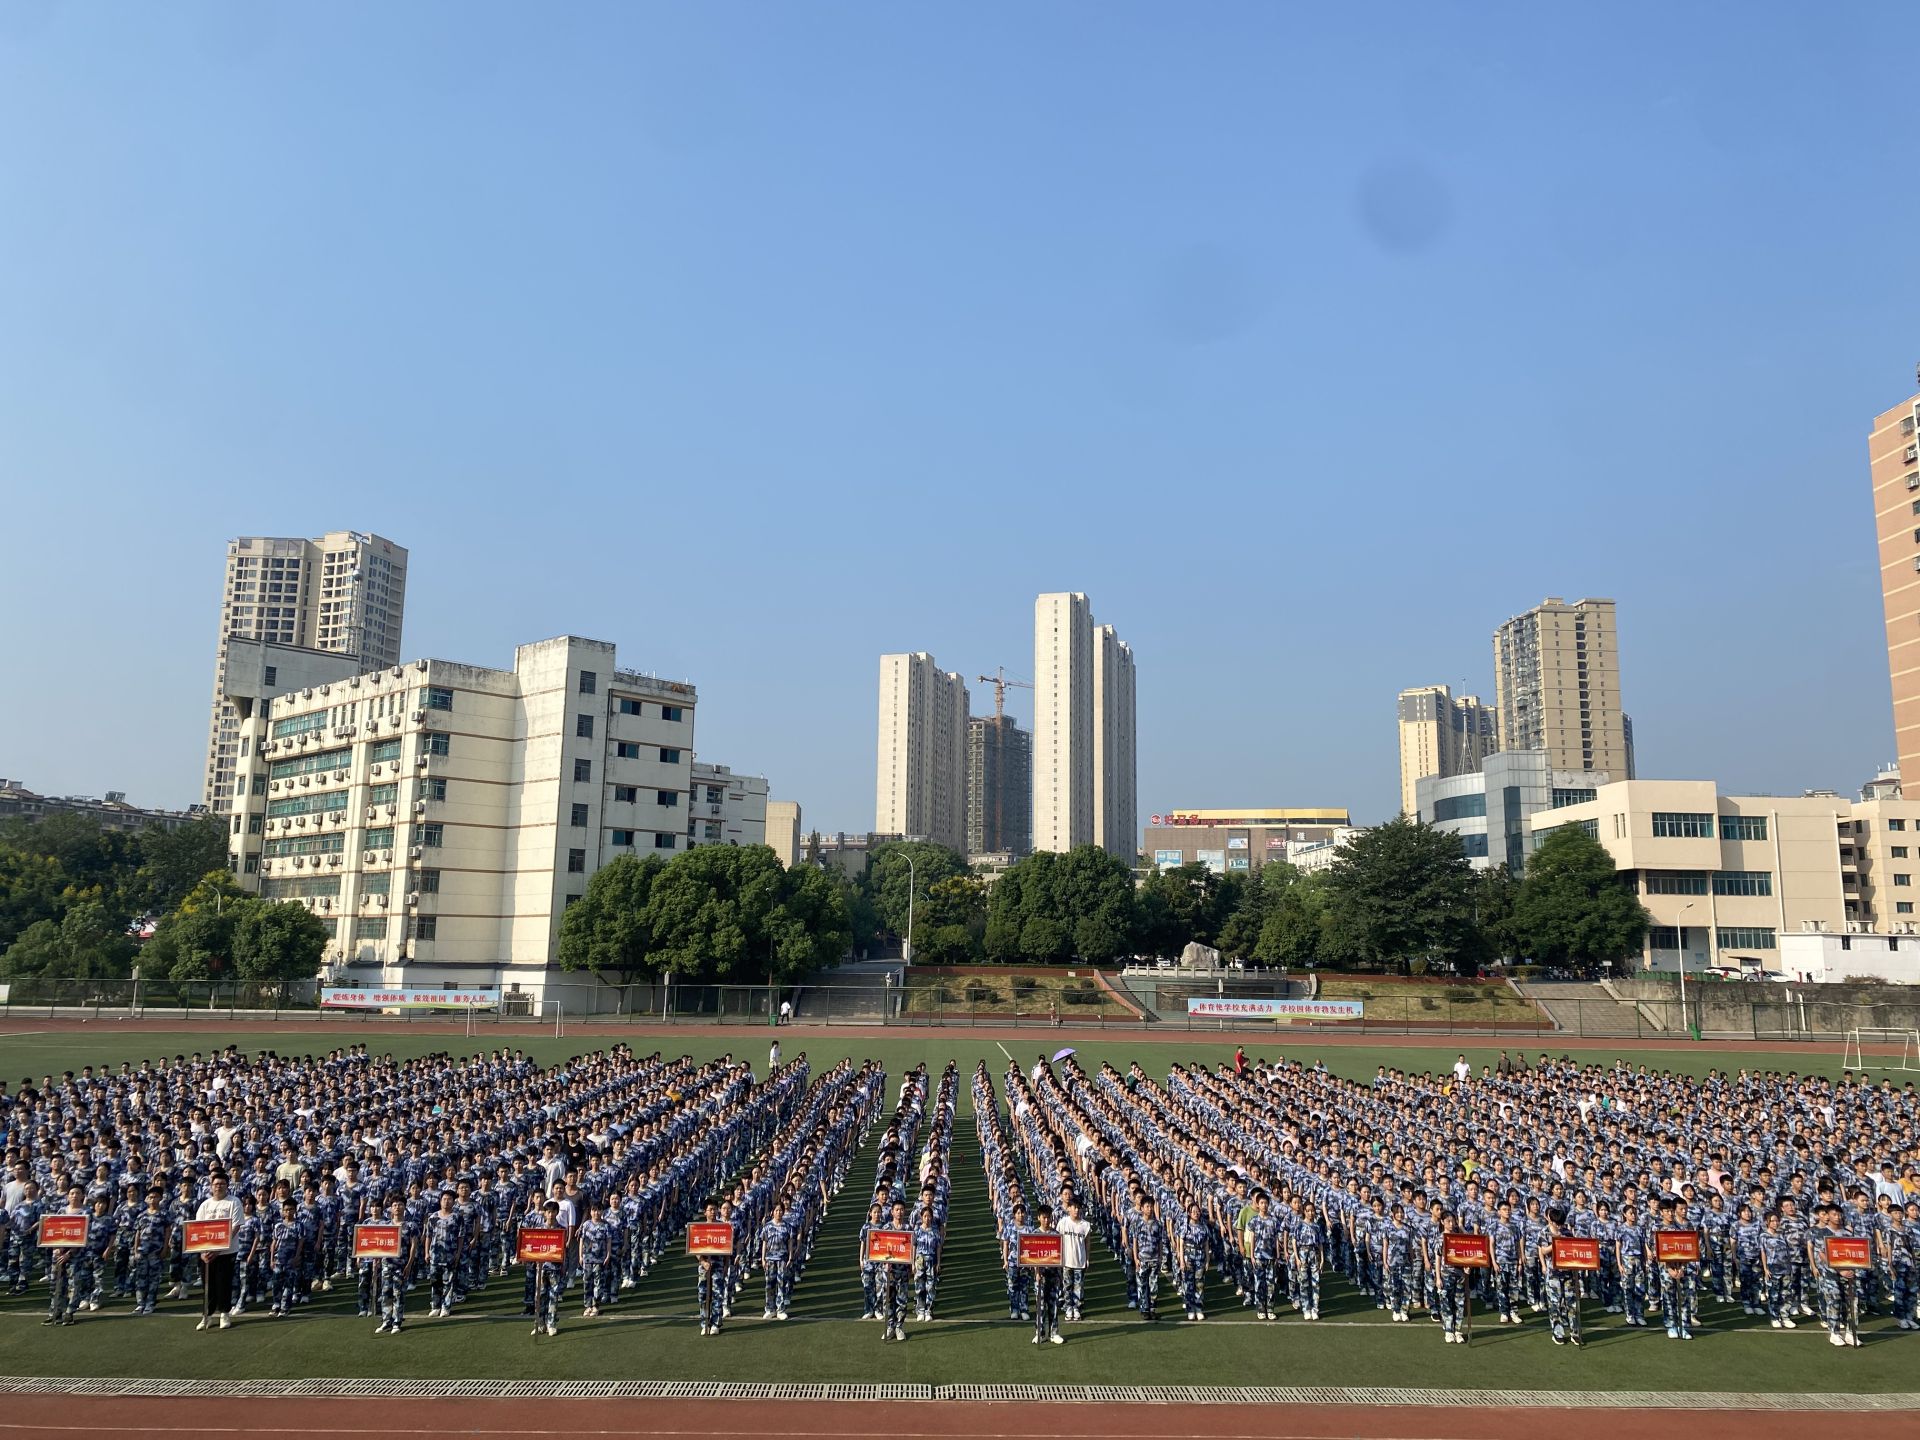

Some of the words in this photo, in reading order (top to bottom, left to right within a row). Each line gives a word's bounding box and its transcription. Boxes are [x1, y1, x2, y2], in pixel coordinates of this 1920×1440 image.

[373, 994, 406, 1002] 增强体质
[414, 994, 446, 1003] 报效祖国
[453, 994, 487, 1003] 服务人民
[1199, 1003, 1272, 1013] 体育使学校充满活力
[46, 1229, 81, 1237] 高一(6)班
[190, 1232, 227, 1241] 高一(7)班
[360, 1238, 395, 1247] 高一(8)班
[693, 1235, 727, 1245] 高一(10)班
[525, 1244, 556, 1252] 高一(9)班
[1022, 1249, 1058, 1258] 高一(12)班
[1447, 1248, 1483, 1258] 高一(15)班
[1559, 1250, 1592, 1259] 高一(16)班
